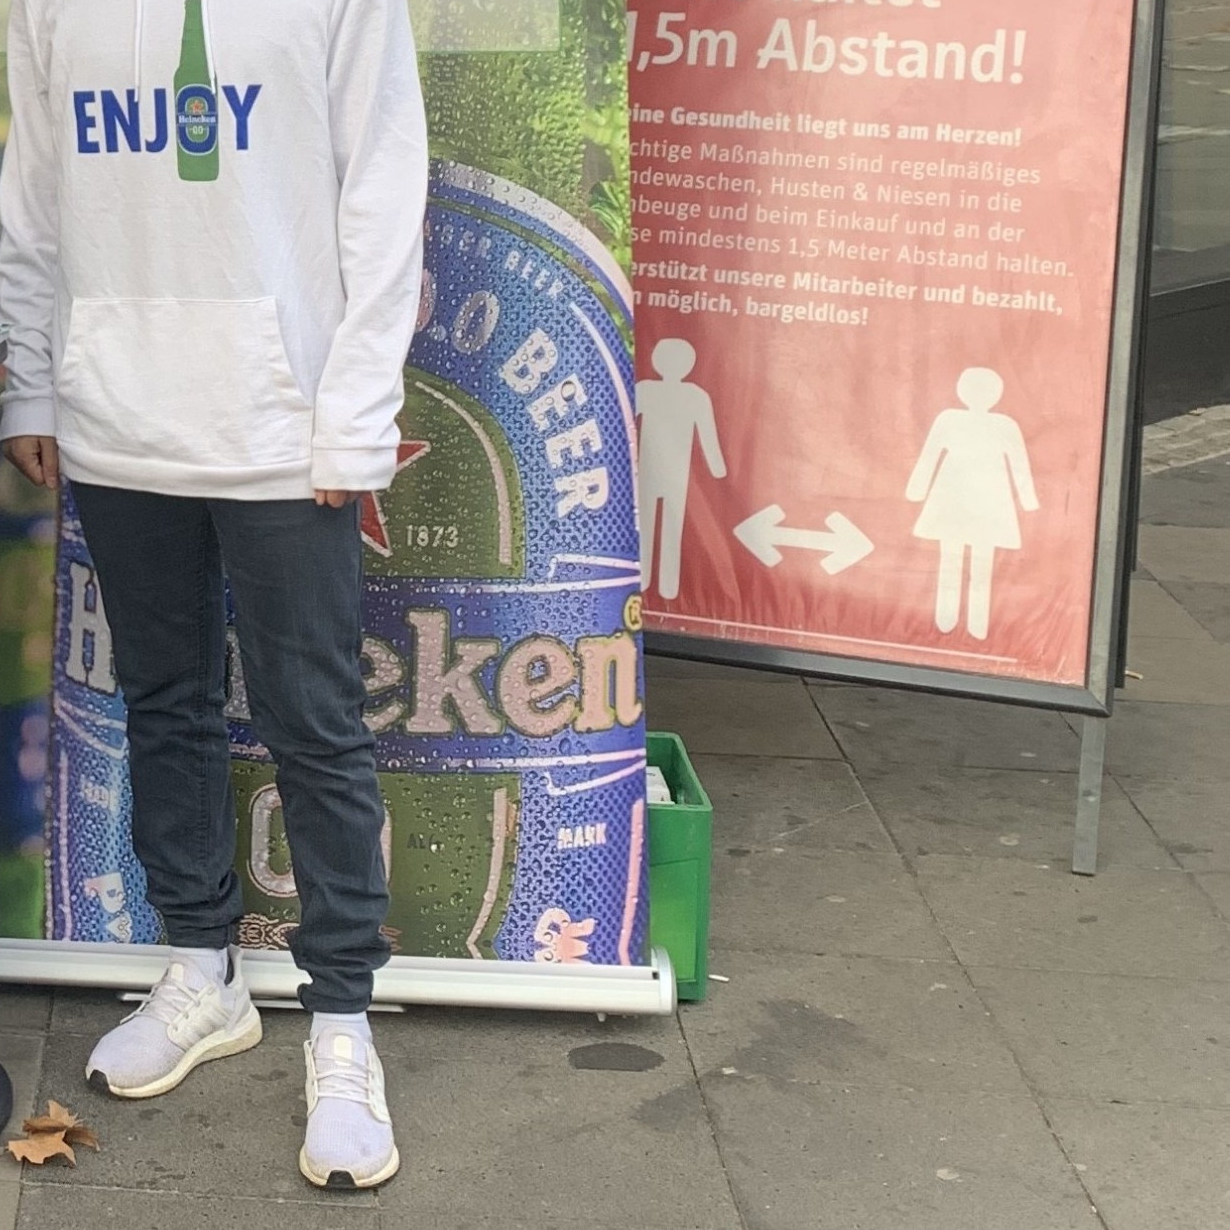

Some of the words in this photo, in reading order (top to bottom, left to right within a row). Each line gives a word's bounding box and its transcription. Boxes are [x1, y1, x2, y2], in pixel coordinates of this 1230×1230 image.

[756, 17, 1027, 85] Abstand!
[73, 84, 263, 156] ENJOY
[670, 106, 791, 133] Gesundheit
[797, 114, 847, 140] liegt
[853, 121, 891, 139] uns
[897, 124, 929, 141] am
[936, 123, 1022, 147] Herzen!
[699, 142, 830, 170] Maßnahmen
[837, 152, 884, 174] sind
[890, 157, 1042, 187] regelmäßiges
[770, 176, 846, 200] Husten
[852, 182, 869, 203] &
[877, 184, 951, 208] Niesen
[959, 189, 980, 210] in
[987, 191, 1023, 213] die
[708, 202, 749, 222] und
[756, 203, 808, 226] beim
[816, 208, 900, 234] Einkauf
[905, 216, 946, 238] und
[953, 222, 980, 240] an
[987, 221, 1026, 243] der
[659, 226, 782, 254] mindestens
[787, 237, 820, 259] 1,5
[827, 239, 891, 263] Meter
[897, 244, 989, 271] Abstand
[996, 251, 1075, 278] halten.
[648, 288, 739, 318] möglich,
[744, 296, 869, 326] bargeldlos!
[713, 269, 786, 290] unsere
[792, 270, 918, 301] Mitarbeiter
[924, 283, 966, 305] und
[971, 284, 1064, 316] bezahlt,
[498, 327, 610, 518] BEER
[406, 524, 460, 548] 1873
[556, 822, 608, 850] MARK
